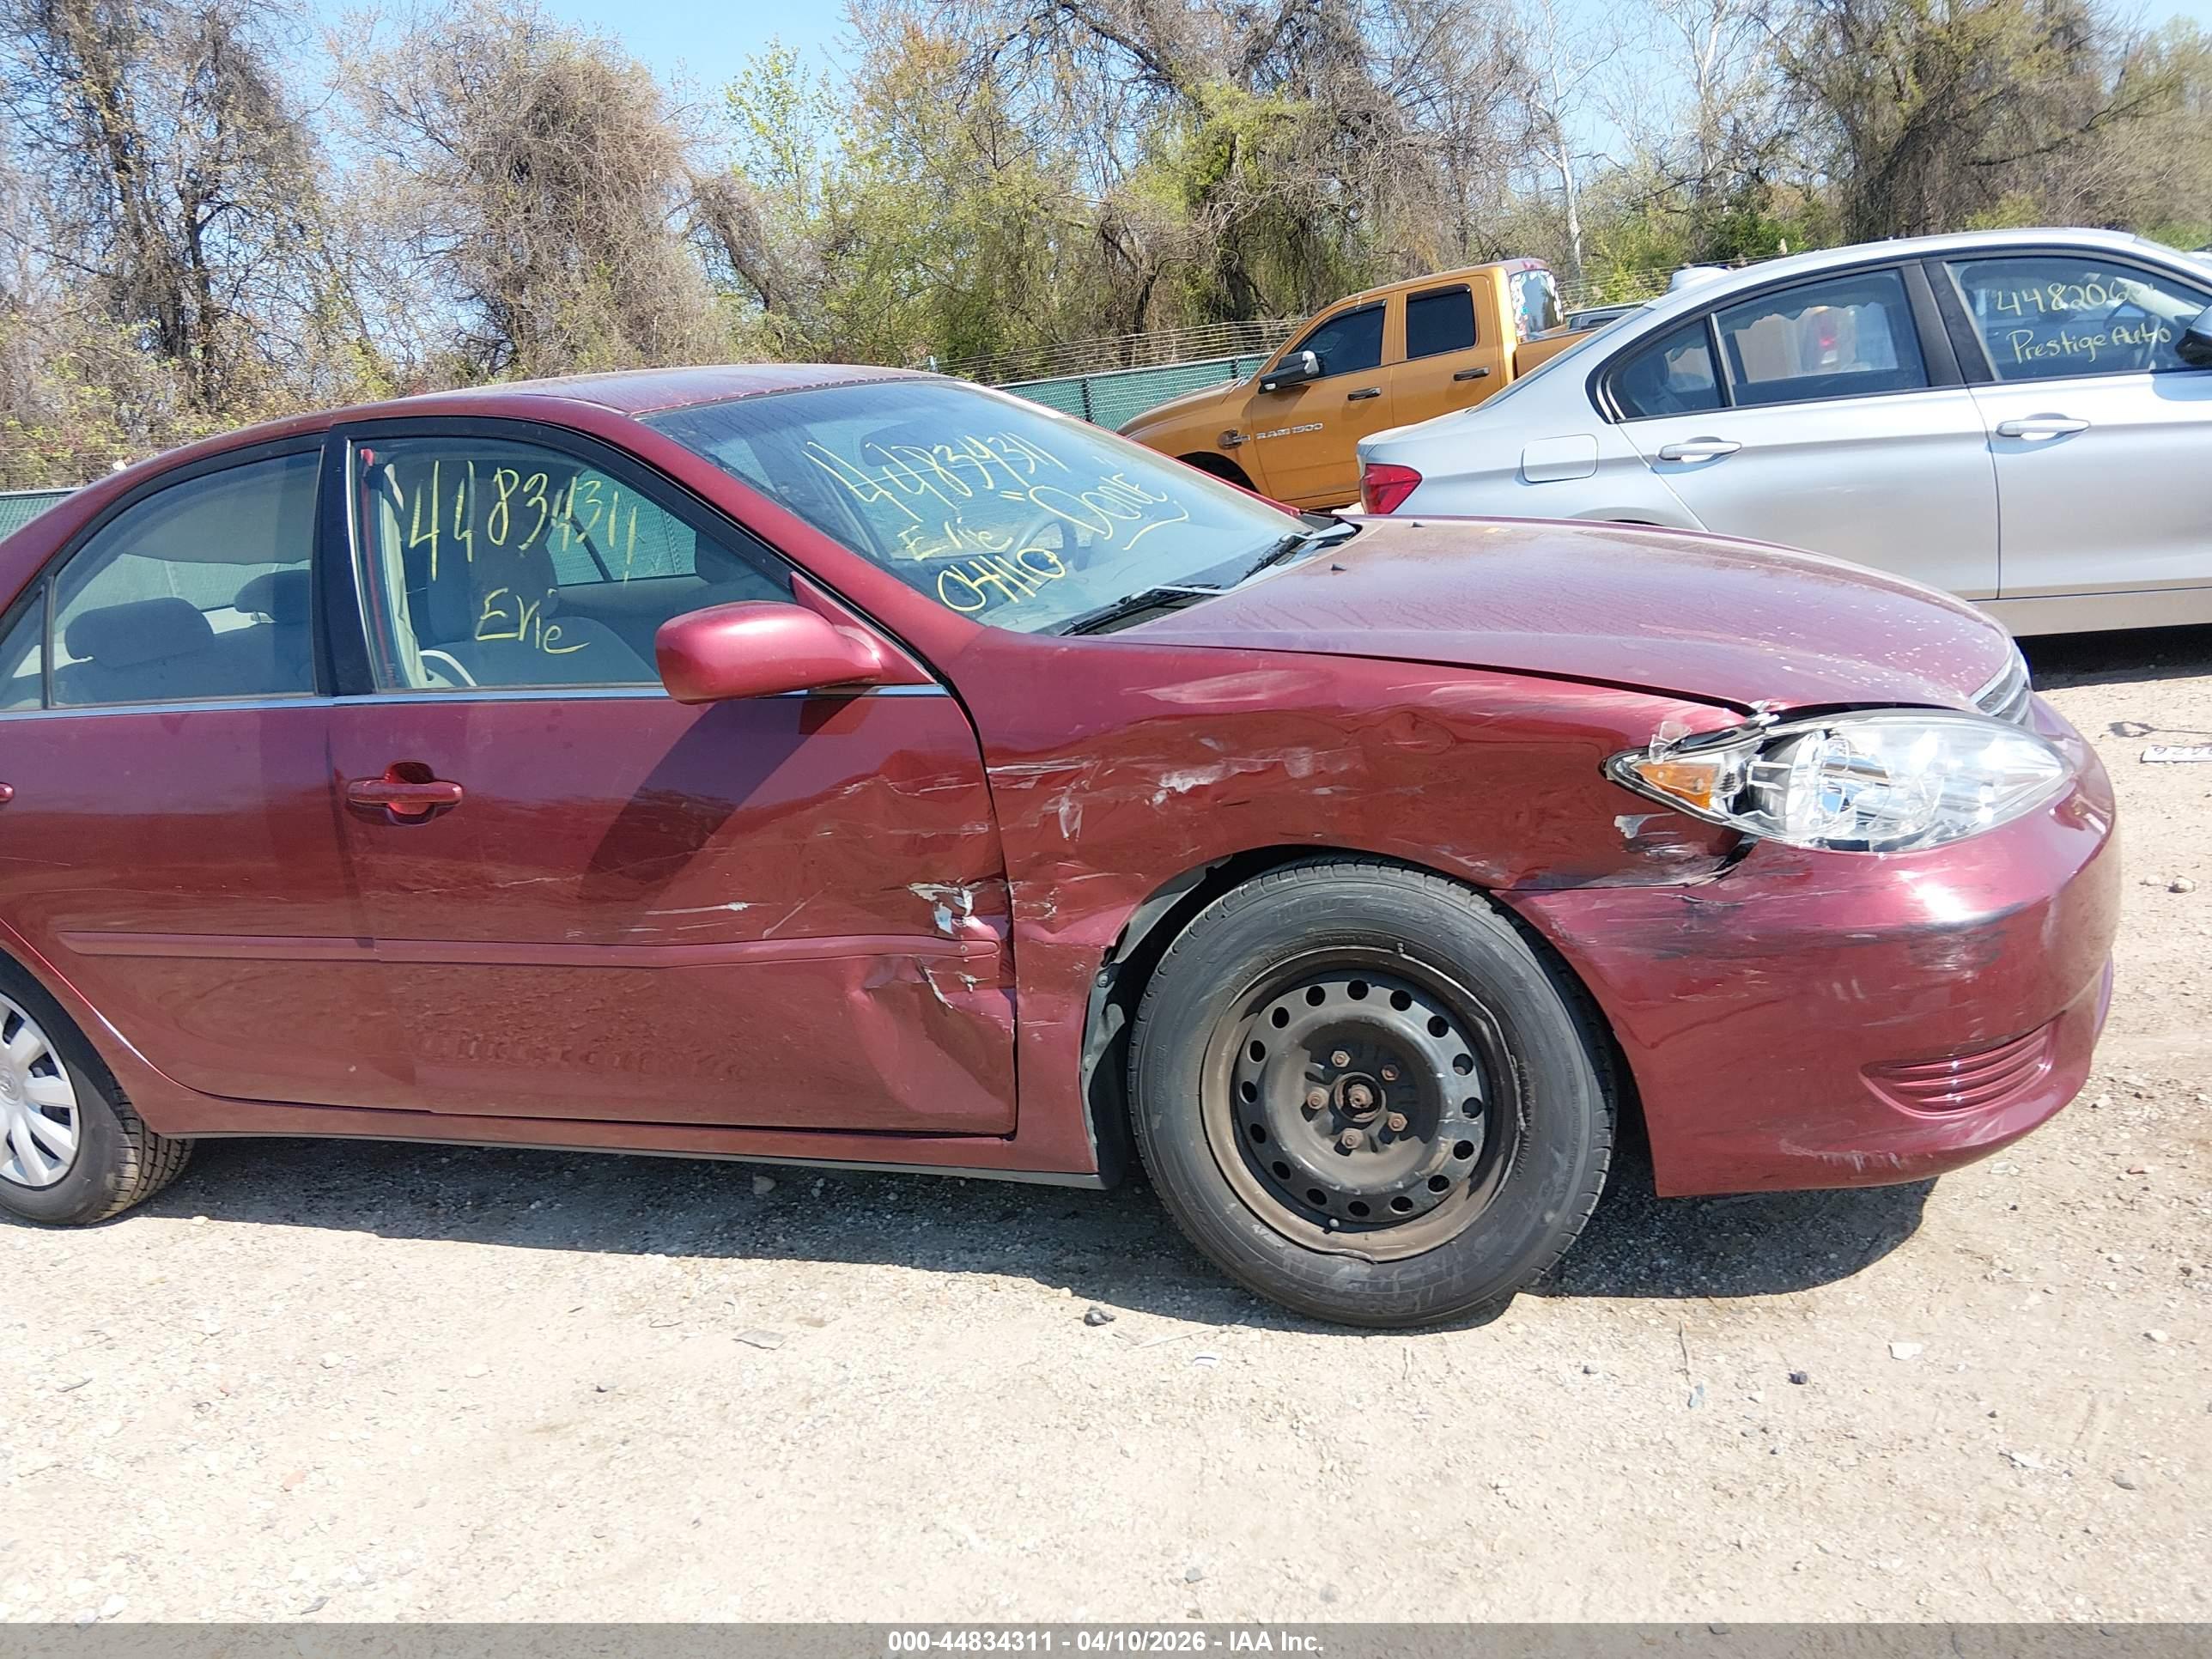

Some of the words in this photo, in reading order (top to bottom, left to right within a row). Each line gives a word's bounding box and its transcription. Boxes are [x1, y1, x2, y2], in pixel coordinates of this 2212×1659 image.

[2006, 329, 2107, 364] Prestige
[2112, 322, 2172, 346] Auto
[1255, 428, 1291, 440] RAM
[1291, 422, 1323, 434] 1500
[474, 587, 591, 653] Evie
